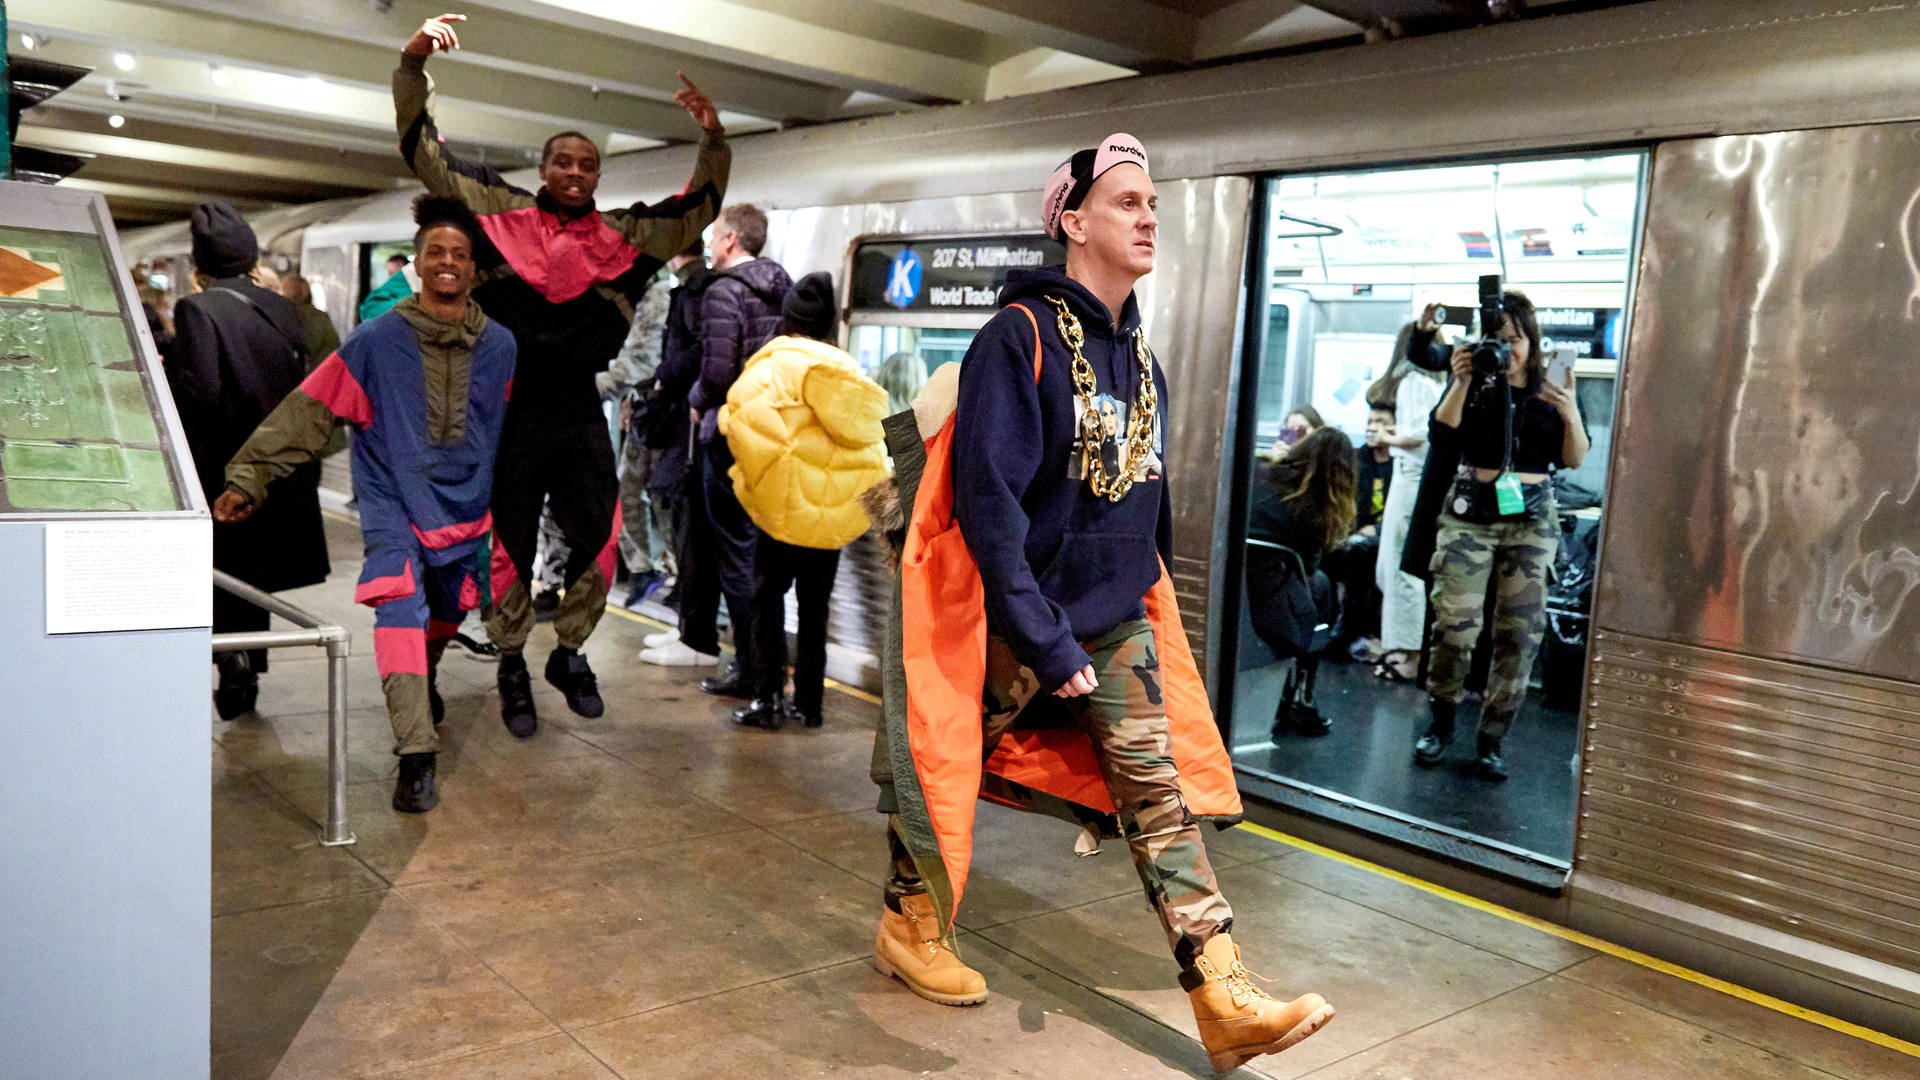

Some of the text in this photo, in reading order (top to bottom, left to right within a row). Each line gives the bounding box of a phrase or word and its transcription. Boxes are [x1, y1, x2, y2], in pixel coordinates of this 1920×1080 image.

[932, 248, 957, 268] 207
[976, 246, 1044, 267] Manhattan
[893, 259, 916, 298] K
[929, 286, 963, 306] World
[963, 286, 996, 306] Trade
[1536, 308, 1595, 325] nhattan
